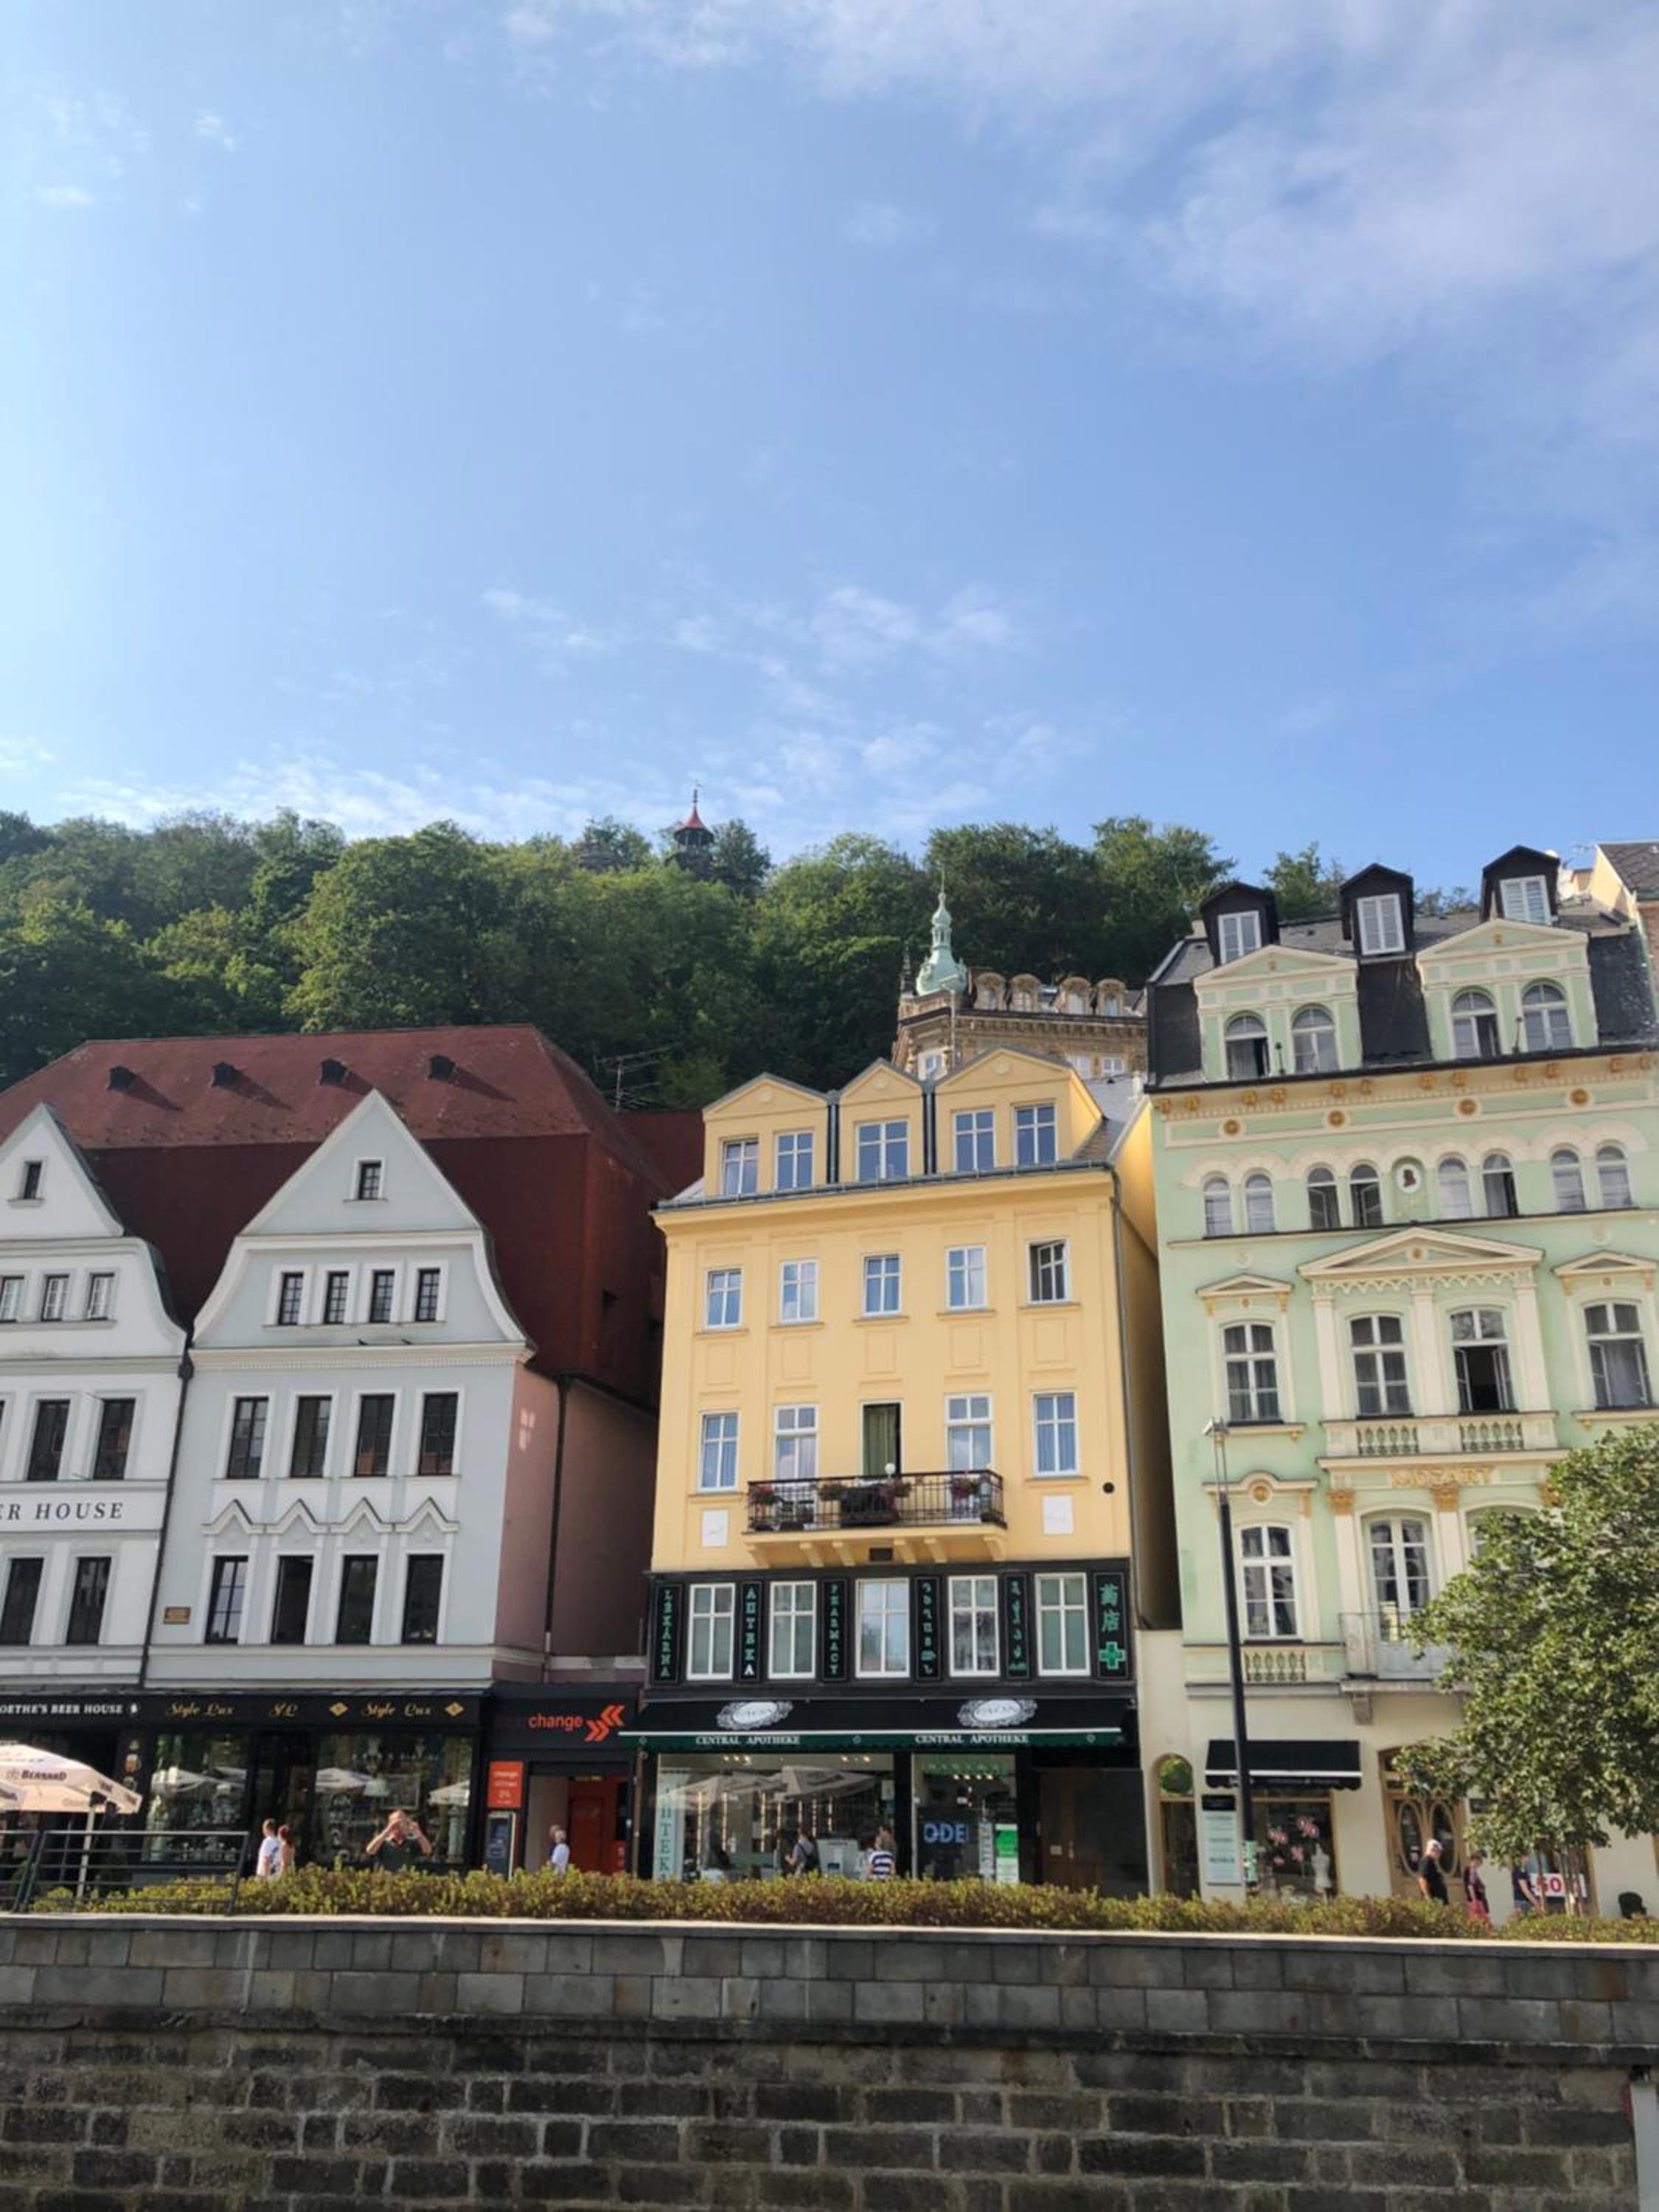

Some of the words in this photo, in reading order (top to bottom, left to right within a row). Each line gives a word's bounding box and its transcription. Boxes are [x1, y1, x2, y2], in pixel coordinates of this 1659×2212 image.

[0, 1503, 21, 1520] R
[35, 1502, 123, 1520] HOUSE
[51, 1704, 80, 1714] BEER
[84, 1704, 122, 1714] HOUSE
[529, 1714, 583, 1731] change
[696, 1736, 741, 1745] CENTRAL
[747, 1736, 800, 1745] APOTHEKE
[915, 1734, 963, 1743] CENTRAL
[970, 1734, 1029, 1743] APOTHEKE
